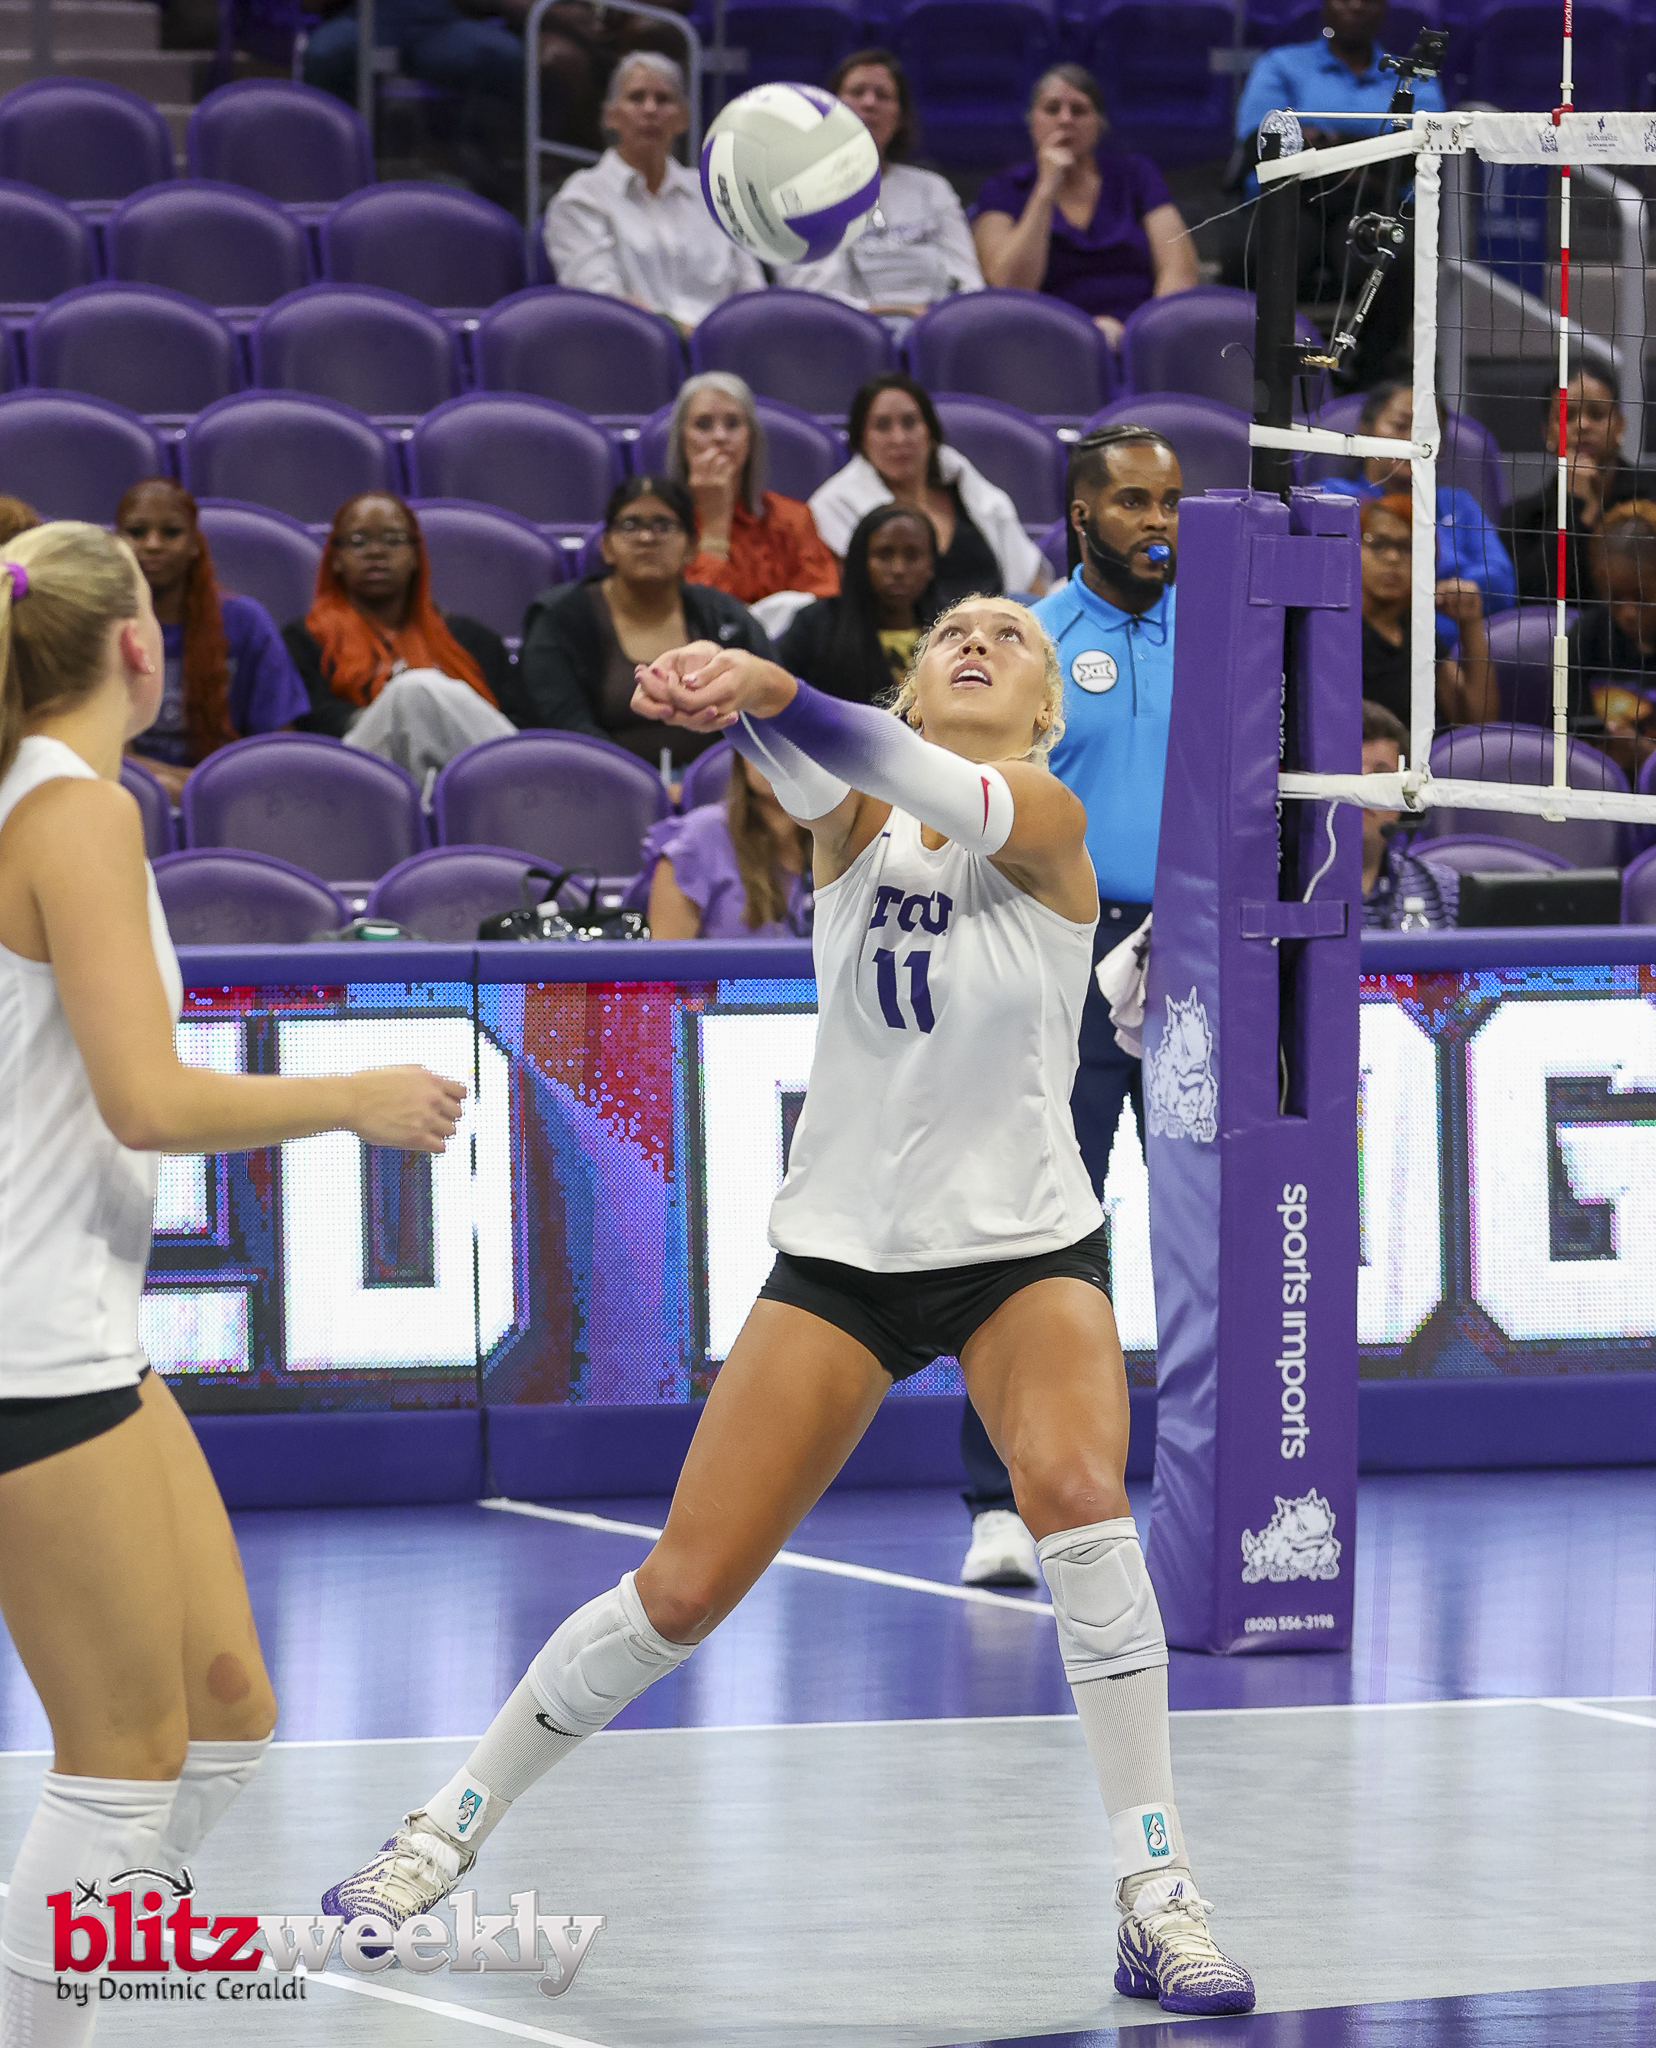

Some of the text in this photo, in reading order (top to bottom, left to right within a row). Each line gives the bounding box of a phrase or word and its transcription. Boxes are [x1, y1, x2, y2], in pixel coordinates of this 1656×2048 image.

[869, 885, 953, 936] TCU
[872, 947, 936, 1034] 11
[1274, 1183, 1312, 1460] sports imports
[1244, 1616, 1277, 1633] (800)
